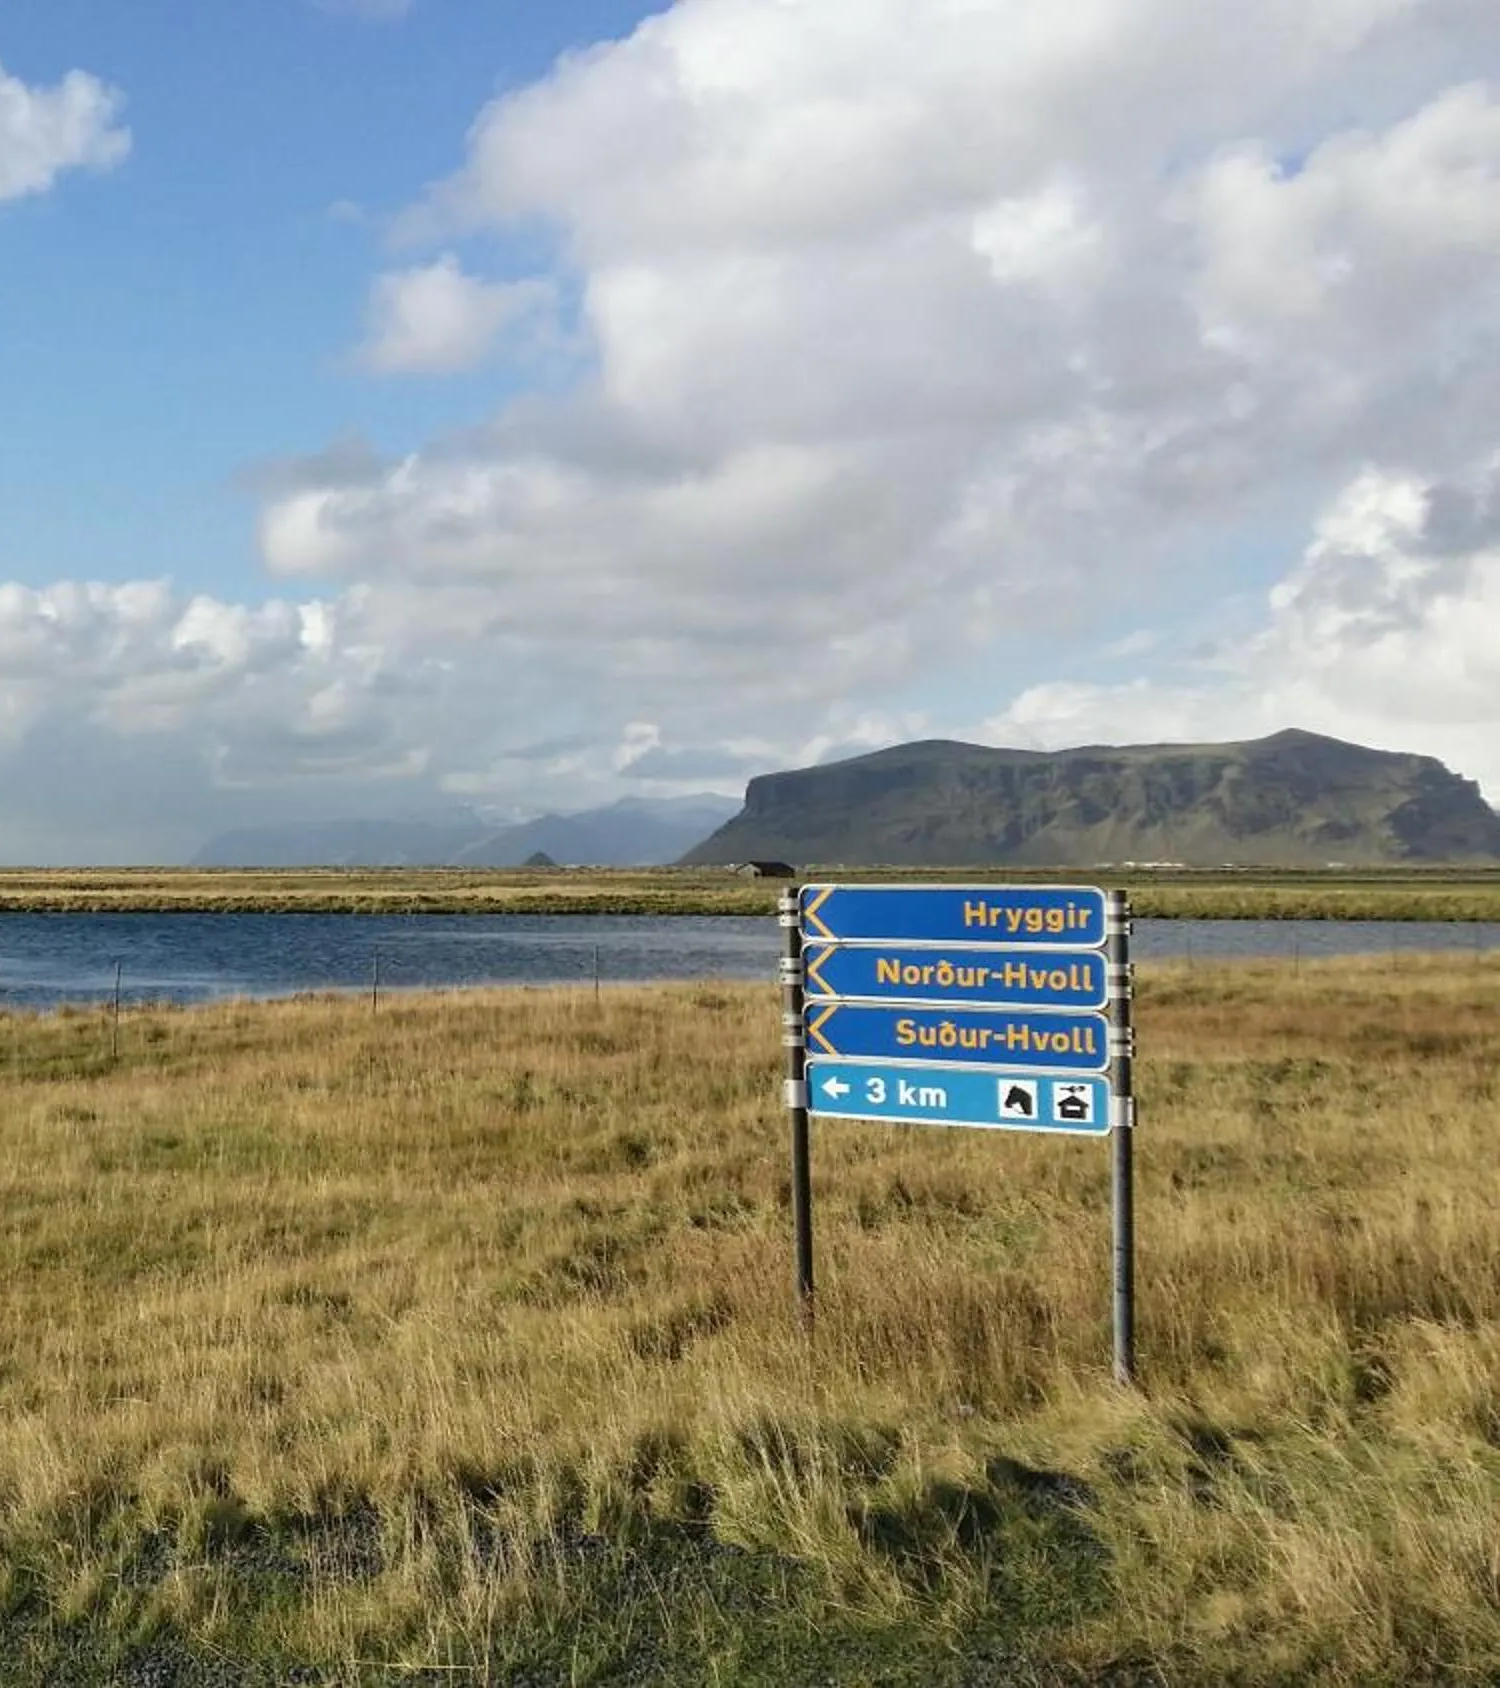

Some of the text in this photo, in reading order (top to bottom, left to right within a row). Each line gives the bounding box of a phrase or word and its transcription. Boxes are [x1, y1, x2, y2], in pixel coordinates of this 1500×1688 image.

[964, 901, 1092, 932] Hryggir
[876, 958, 1094, 991] Norður-Hvoll
[896, 1019, 1097, 1054] Suður-Hvoll
[866, 1077, 947, 1108] 3 km
